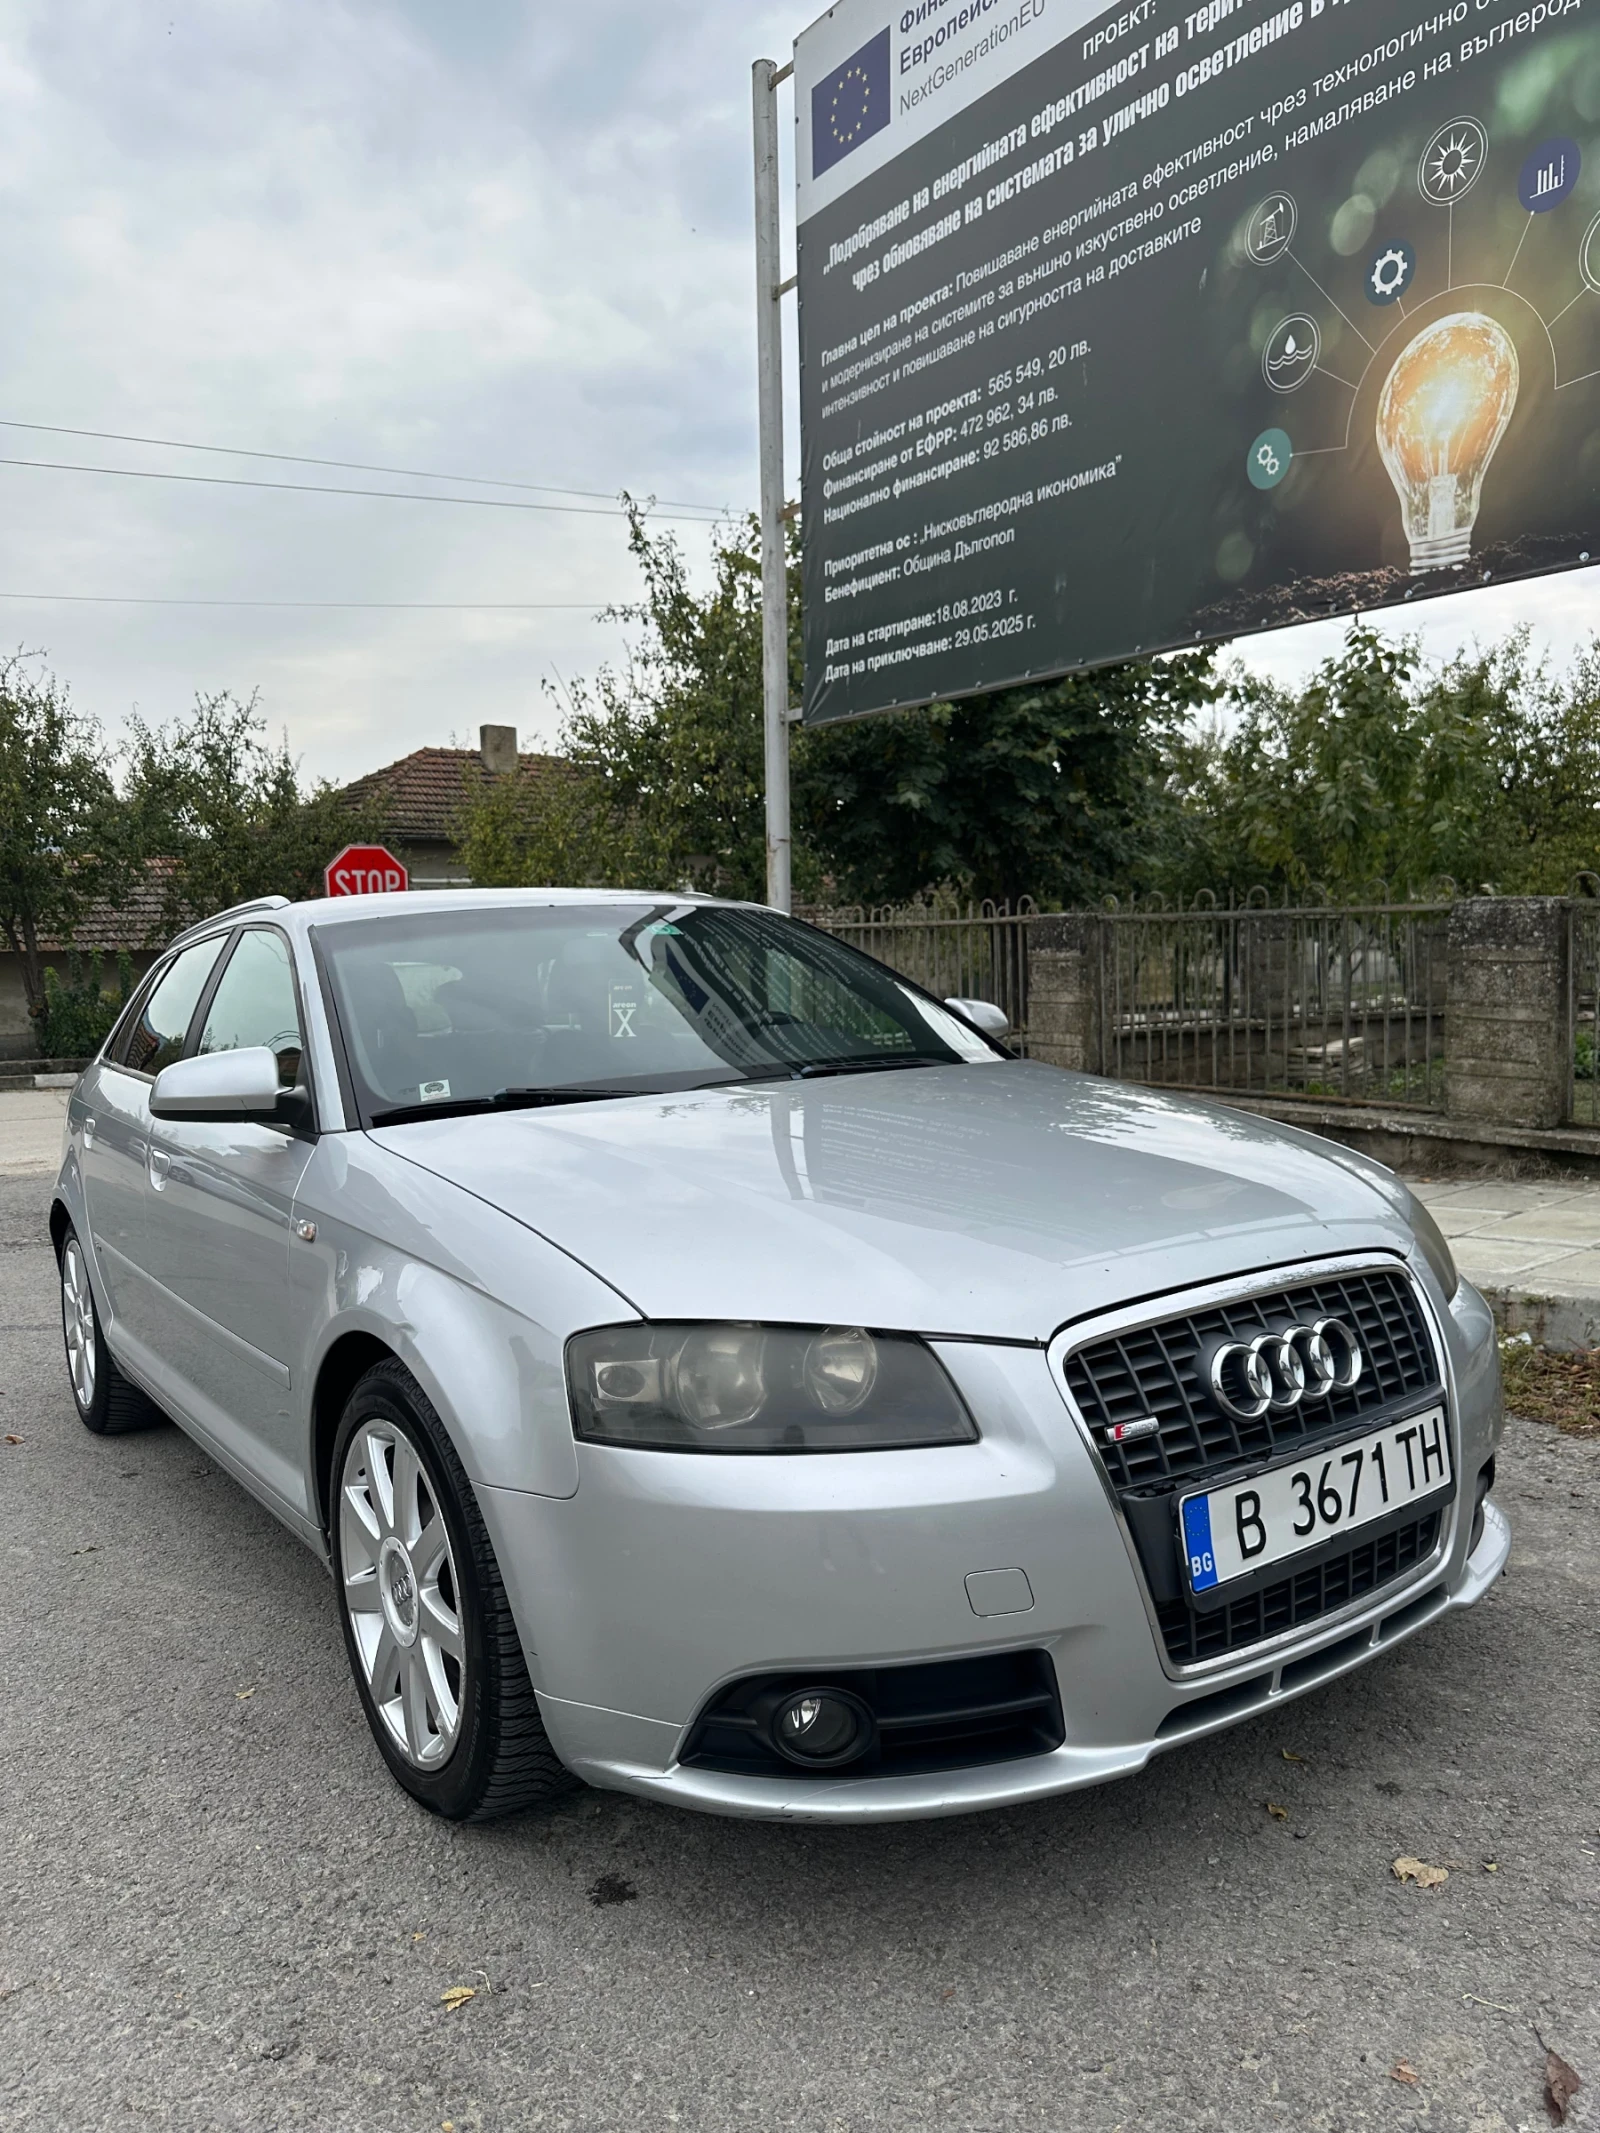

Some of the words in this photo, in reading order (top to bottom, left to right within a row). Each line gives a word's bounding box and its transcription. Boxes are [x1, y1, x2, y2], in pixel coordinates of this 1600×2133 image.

[900, 0, 1045, 116] NextGenerationEU
[1083, 0, 1156, 60] ПРОЕКТ:
[852, 260, 880, 292] чрез
[882, 209, 961, 274] обновяване
[964, 196, 983, 225] на
[986, 141, 1074, 211] системата
[1078, 126, 1098, 157] за
[1102, 82, 1170, 147] улично
[1175, 1, 1303, 98] осветление
[912, 187, 930, 214] на
[932, 123, 1027, 201] енергийната
[1031, 43, 1150, 138] ефективност
[1155, 25, 1179, 60] на
[821, 336, 858, 367] Главна
[859, 323, 881, 347] цел
[883, 314, 897, 333] на
[900, 283, 953, 324] проекта:
[956, 235, 1040, 292] Повишаване
[1042, 181, 1138, 245] енергийната
[1142, 116, 1254, 190] ефективност
[1260, 88, 1307, 126] чрез
[1312, 1, 1468, 97] технологично
[821, 379, 828, 393] и
[830, 334, 912, 389] модернизиране
[914, 325, 929, 344] на
[931, 290, 995, 334] системите
[998, 280, 1014, 300] за
[1017, 250, 1072, 290] външно
[1076, 202, 1164, 260] изкуствено
[1168, 144, 1278, 211] осветление,
[1285, 69, 1416, 151] намаляване
[1423, 51, 1452, 80] на
[821, 373, 891, 419] интензивност
[892, 368, 900, 383] и
[902, 330, 976, 378] повишаване
[978, 320, 995, 340] на
[997, 277, 1082, 330] сигурността
[1086, 265, 1105, 287] на
[1108, 216, 1202, 279] доставките
[822, 447, 853, 471] Обща
[854, 421, 906, 456] стойност
[908, 414, 923, 432] на
[925, 387, 981, 425] проекта:
[988, 370, 1013, 396] 565
[1015, 357, 1044, 384] 549,
[1048, 346, 1066, 370] 20
[1069, 340, 1092, 360] лв.
[823, 454, 898, 499] Финансиране
[900, 447, 914, 464] от
[916, 426, 957, 458] ЕФРР:
[960, 414, 983, 437] 472
[986, 402, 1014, 428] 962,
[1017, 391, 1034, 414] 34
[1038, 387, 1059, 407] лв.
[823, 486, 890, 525] Национално
[892, 449, 980, 499] финансиране:
[983, 438, 1000, 459] 92
[1051, 413, 1073, 433] лв.
[824, 541, 894, 577] Приоритетна
[896, 535, 911, 551] ос
[825, 565, 900, 603] Бенефициент:
[903, 550, 951, 577] Община
[954, 527, 1016, 563] Дългопол
[825, 637, 849, 658] Дата
[851, 634, 865, 648] на
[1008, 588, 1019, 603] г.
[825, 664, 849, 683] Дата
[851, 659, 865, 674] на
[867, 637, 952, 672] приключване:
[954, 614, 1024, 648] 29.05.2025
[1027, 614, 1037, 629] г.
[335, 869, 400, 896] STOP
[612, 1009, 637, 1037] X
[1235, 1490, 1267, 1560] B
[1291, 1441, 1389, 1536] 3671
[1395, 1417, 1444, 1491] TH
[1190, 1552, 1213, 1577] BG
